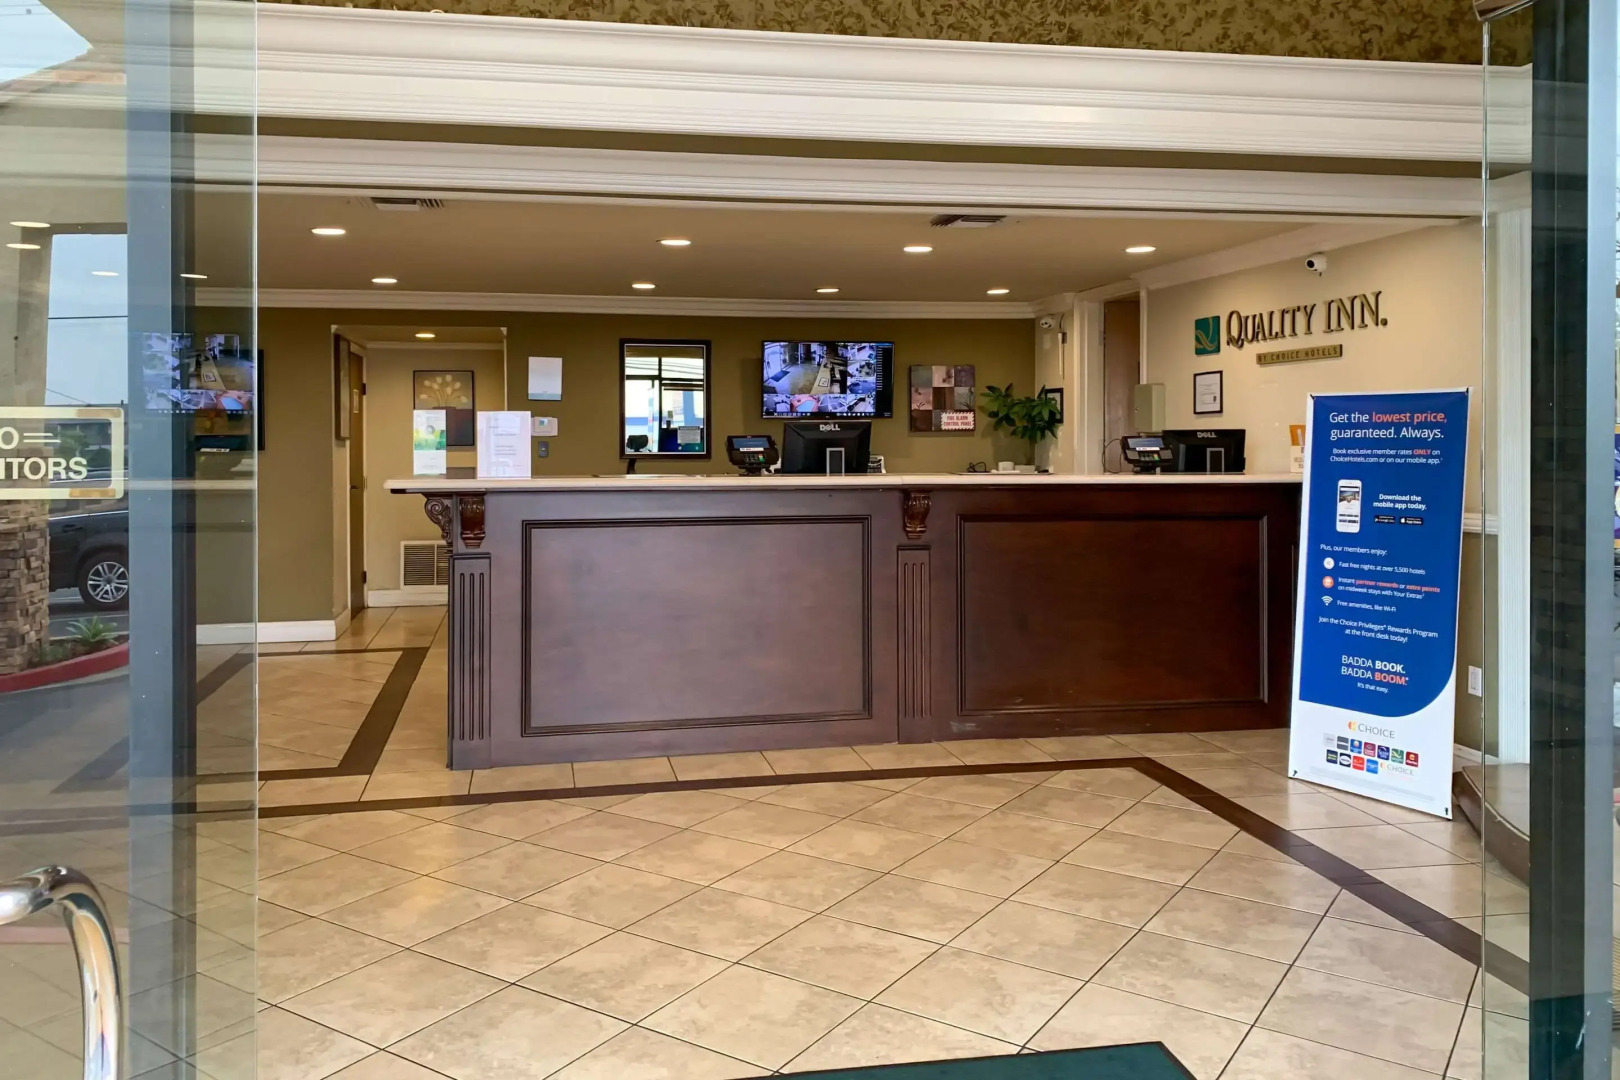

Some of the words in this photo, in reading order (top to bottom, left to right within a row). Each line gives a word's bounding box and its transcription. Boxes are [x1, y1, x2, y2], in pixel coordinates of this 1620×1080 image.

[1226, 303, 1316, 348] QUALITY
[1323, 291, 1388, 333] INN.
[1257, 354, 1267, 363] BY
[1270, 350, 1300, 361] CHOICE
[1304, 346, 1338, 358] HOTELS
[1329, 412, 1348, 423] Get
[1351, 412, 1369, 423] the
[1372, 411, 1411, 423] lowest
[1414, 411, 1447, 425] price,
[1330, 427, 1397, 441] guaranteed.
[1400, 427, 1444, 441] Always.
[1379, 493, 1409, 501] Download
[1410, 494, 1421, 502] the
[1395, 502, 1406, 510] app
[1407, 502, 1427, 511] today.
[1320, 544, 1332, 552] Plus,
[1344, 546, 1370, 554] members
[1361, 563, 1375, 571] nights
[1346, 585, 1367, 593] midweek
[1355, 579, 1376, 587] partner
[1377, 580, 1399, 588] rewards
[1349, 601, 1374, 610] amenities,
[1340, 619, 1358, 627] Choice
[1387, 625, 1412, 635] Rewards
[1413, 629, 1438, 638] Program
[1361, 630, 1376, 638] front
[1376, 632, 1390, 640] desk
[1390, 635, 1408, 643] today!
[1341, 655, 1373, 668] BADDA
[1375, 660, 1406, 674] BOOK.
[1341, 666, 1373, 679] BADDA
[1376, 686, 1389, 694] easy.
[1357, 723, 1396, 739] CHOICE
[1387, 763, 1415, 776] CHOICE
